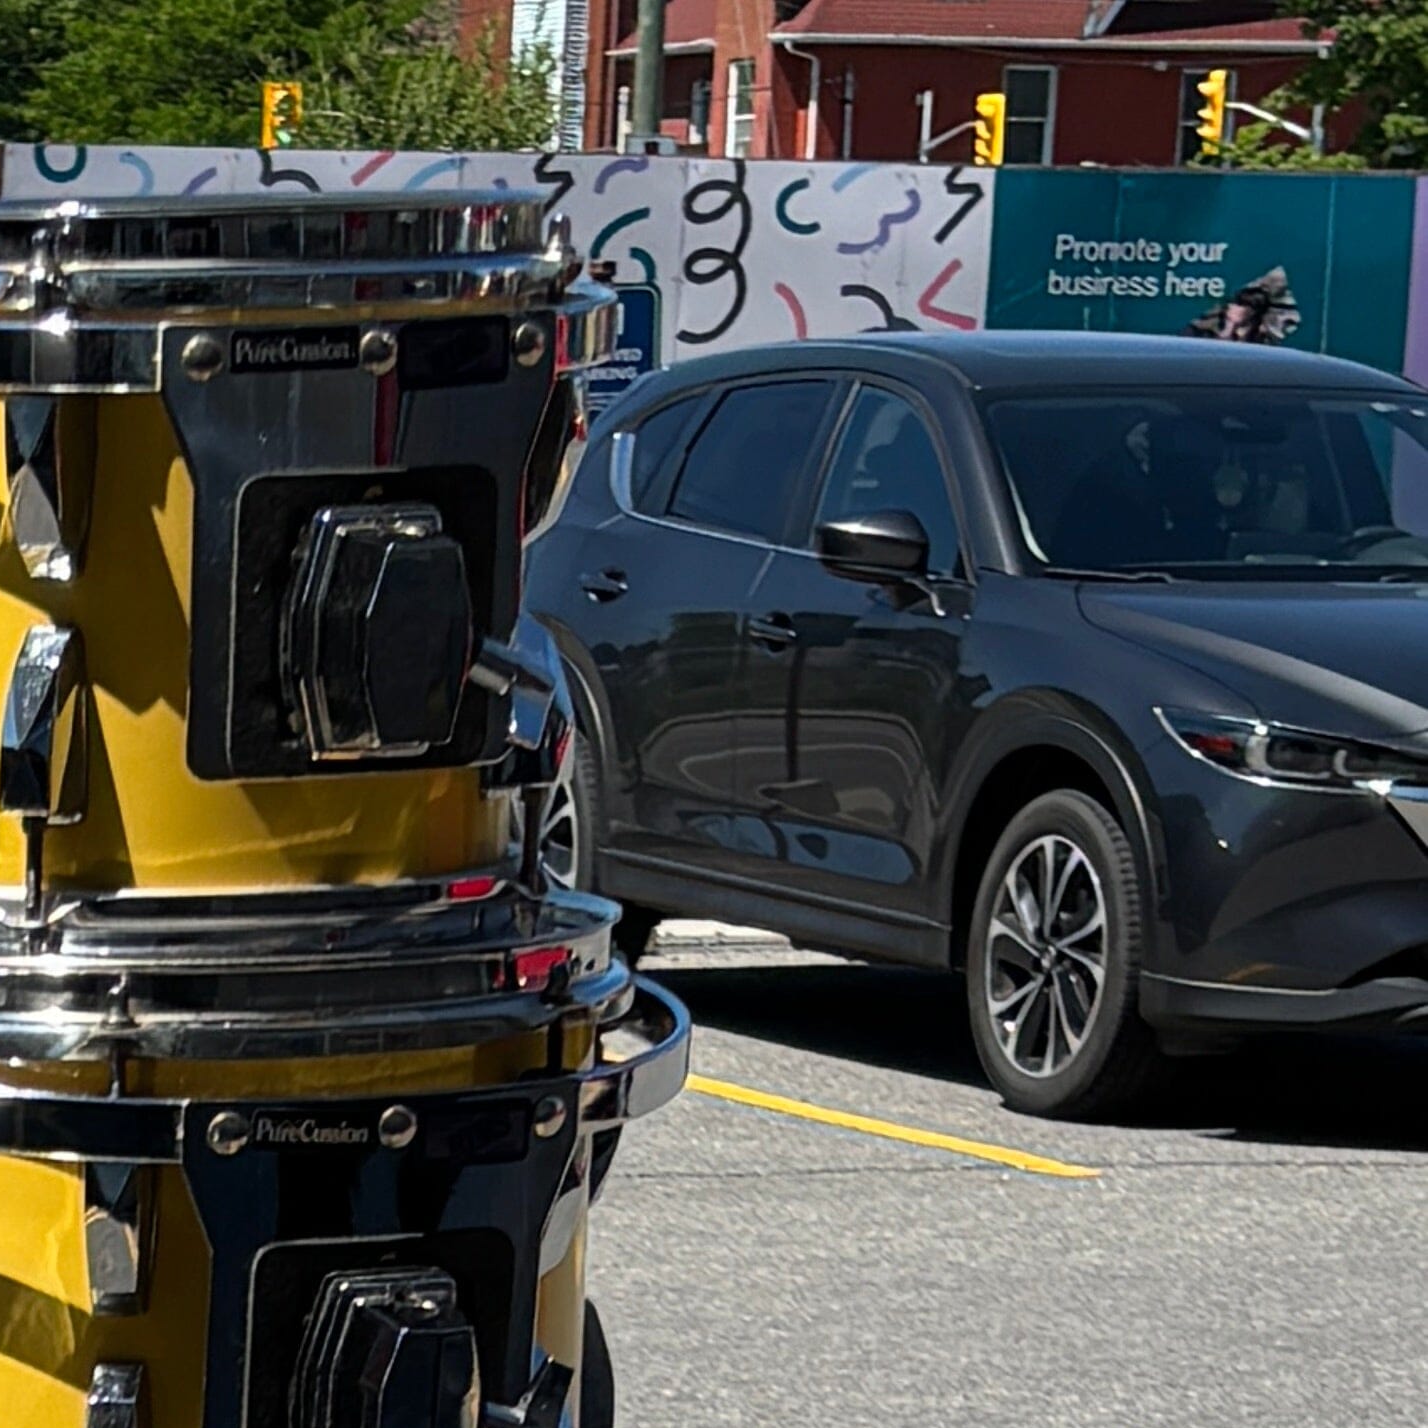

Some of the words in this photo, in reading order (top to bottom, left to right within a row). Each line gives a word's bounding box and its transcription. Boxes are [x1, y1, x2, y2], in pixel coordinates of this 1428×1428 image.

[1055, 234, 1163, 262] Promote
[1168, 242, 1229, 267] your
[1048, 268, 1160, 297] business
[1165, 270, 1226, 297] here
